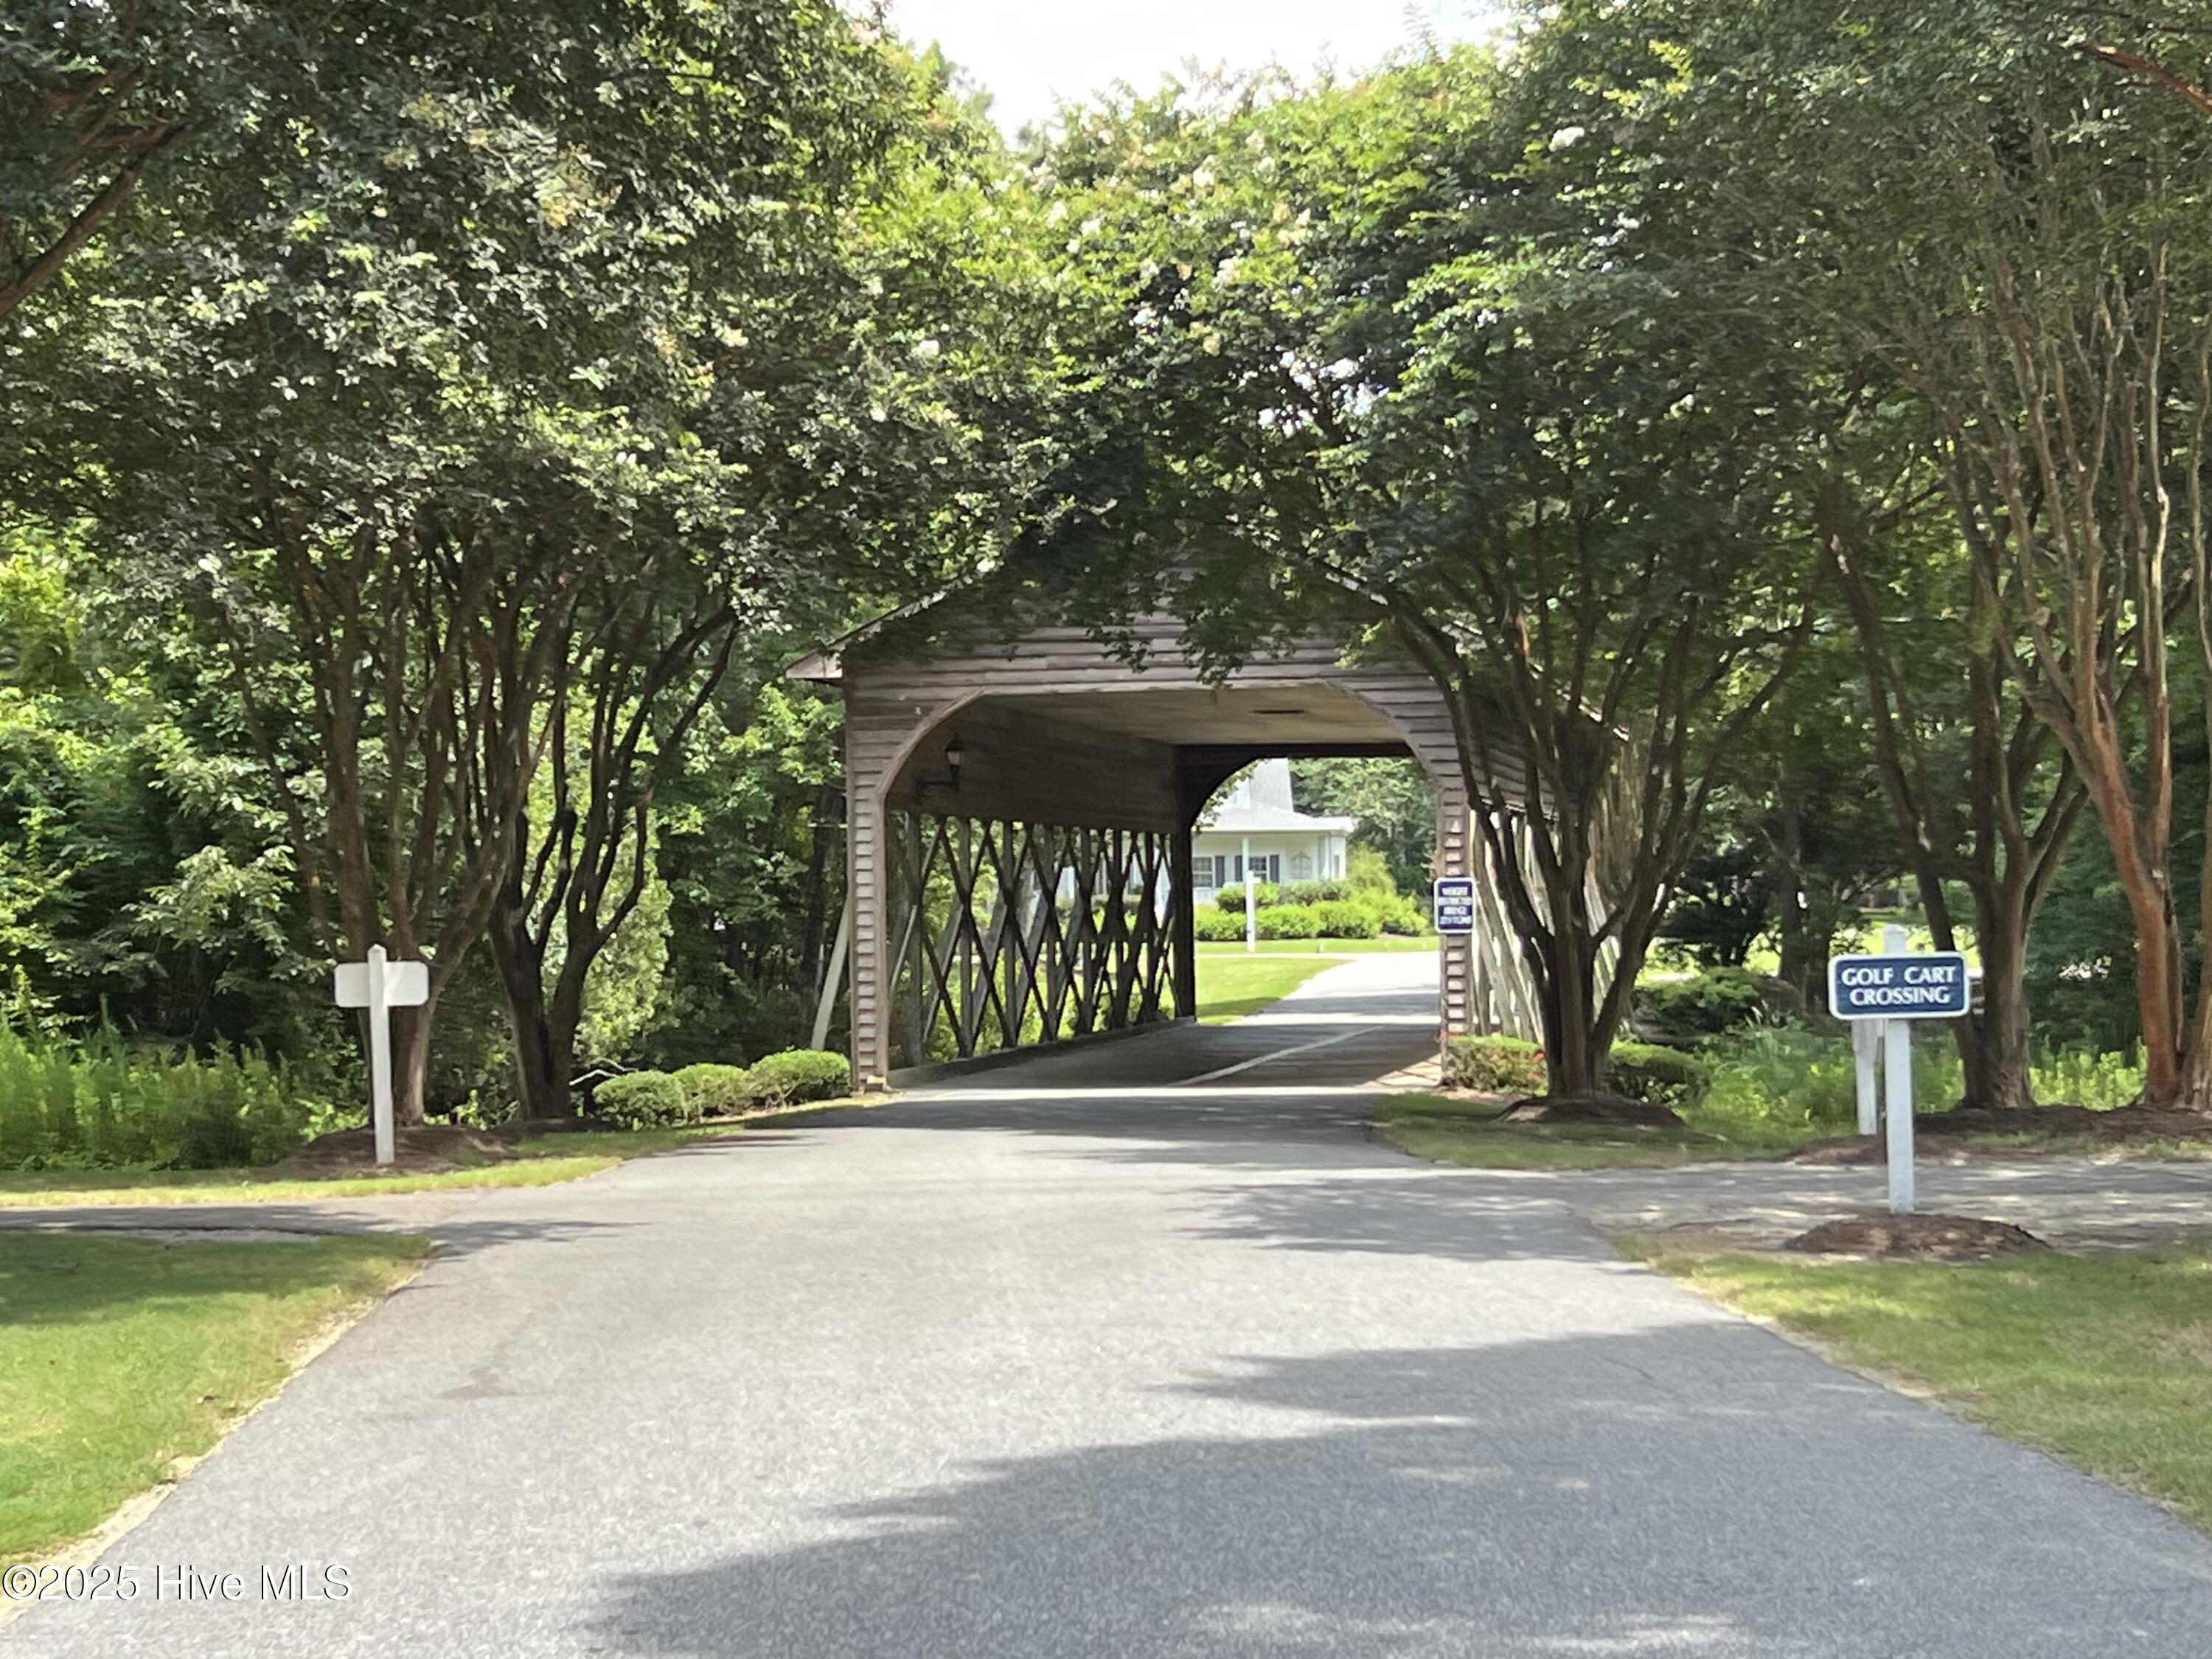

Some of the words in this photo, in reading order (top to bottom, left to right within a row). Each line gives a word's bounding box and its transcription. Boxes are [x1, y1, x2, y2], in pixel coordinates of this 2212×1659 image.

[1841, 967, 1894, 986] GOLF
[1904, 966, 1956, 984] CART
[1849, 986, 1950, 1006] CROSSING
